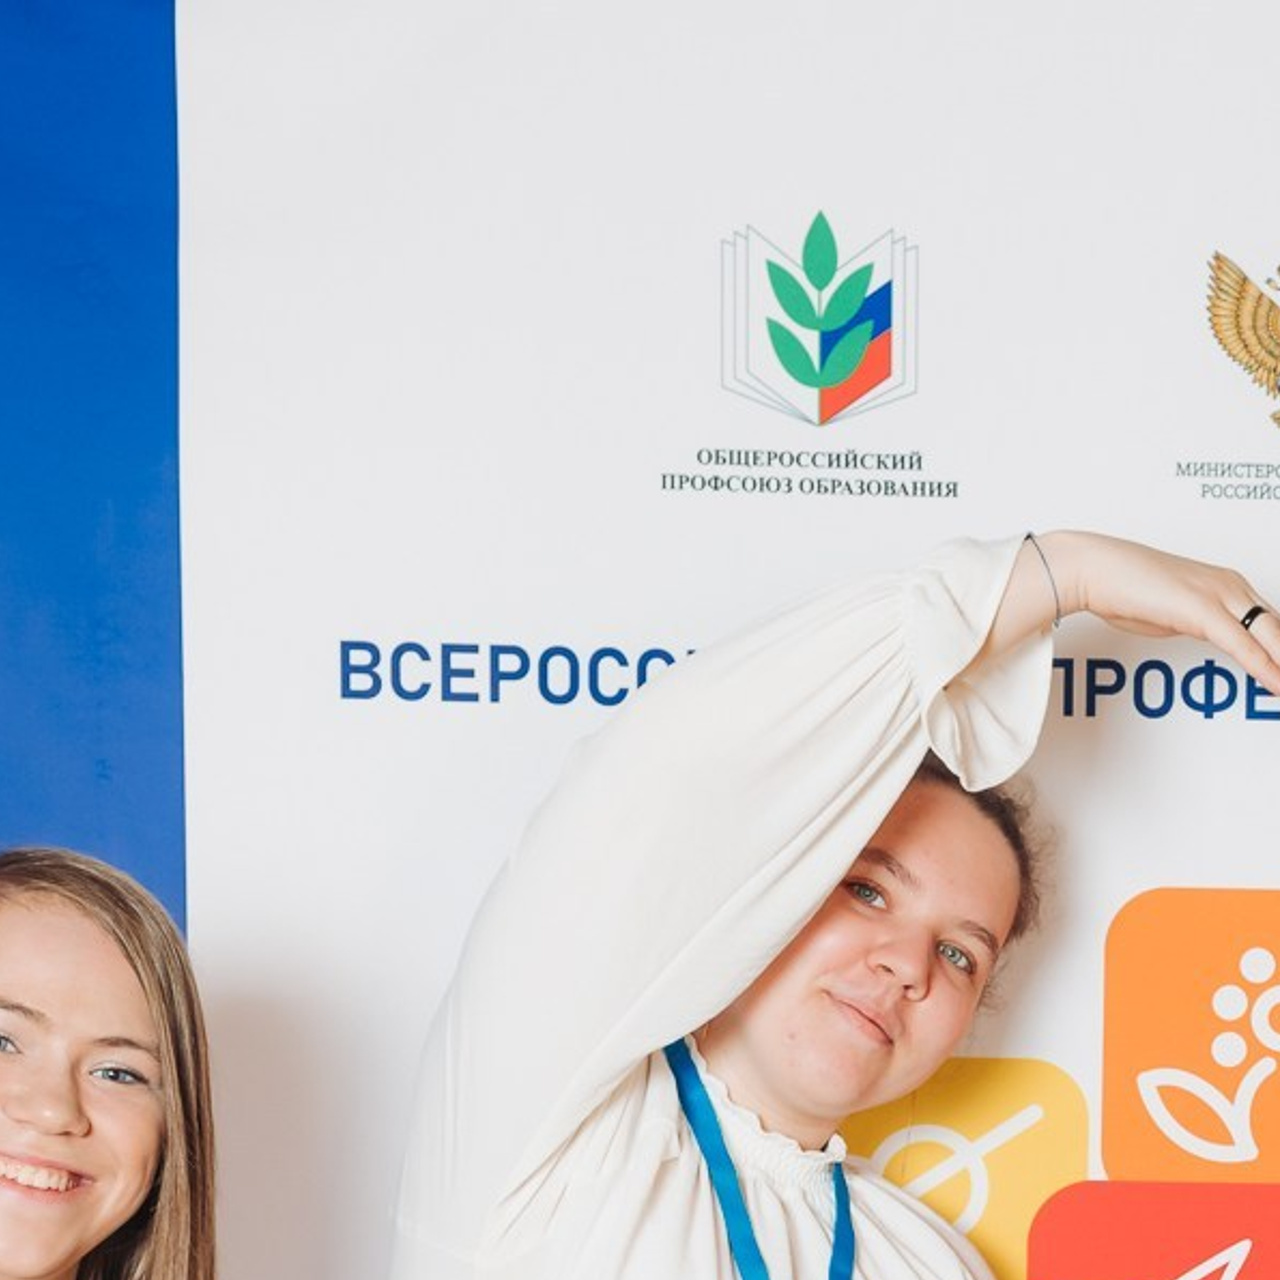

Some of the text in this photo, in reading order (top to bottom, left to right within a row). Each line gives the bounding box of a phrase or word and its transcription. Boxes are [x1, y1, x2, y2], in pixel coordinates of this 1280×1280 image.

[696, 448, 923, 471] ОБЩЕРОССИЙСКИЙ
[660, 474, 959, 498] ПРОФСОЮЗ ОБРАЗОВАНИЯ
[339, 640, 695, 707] ВСЕРОСС
